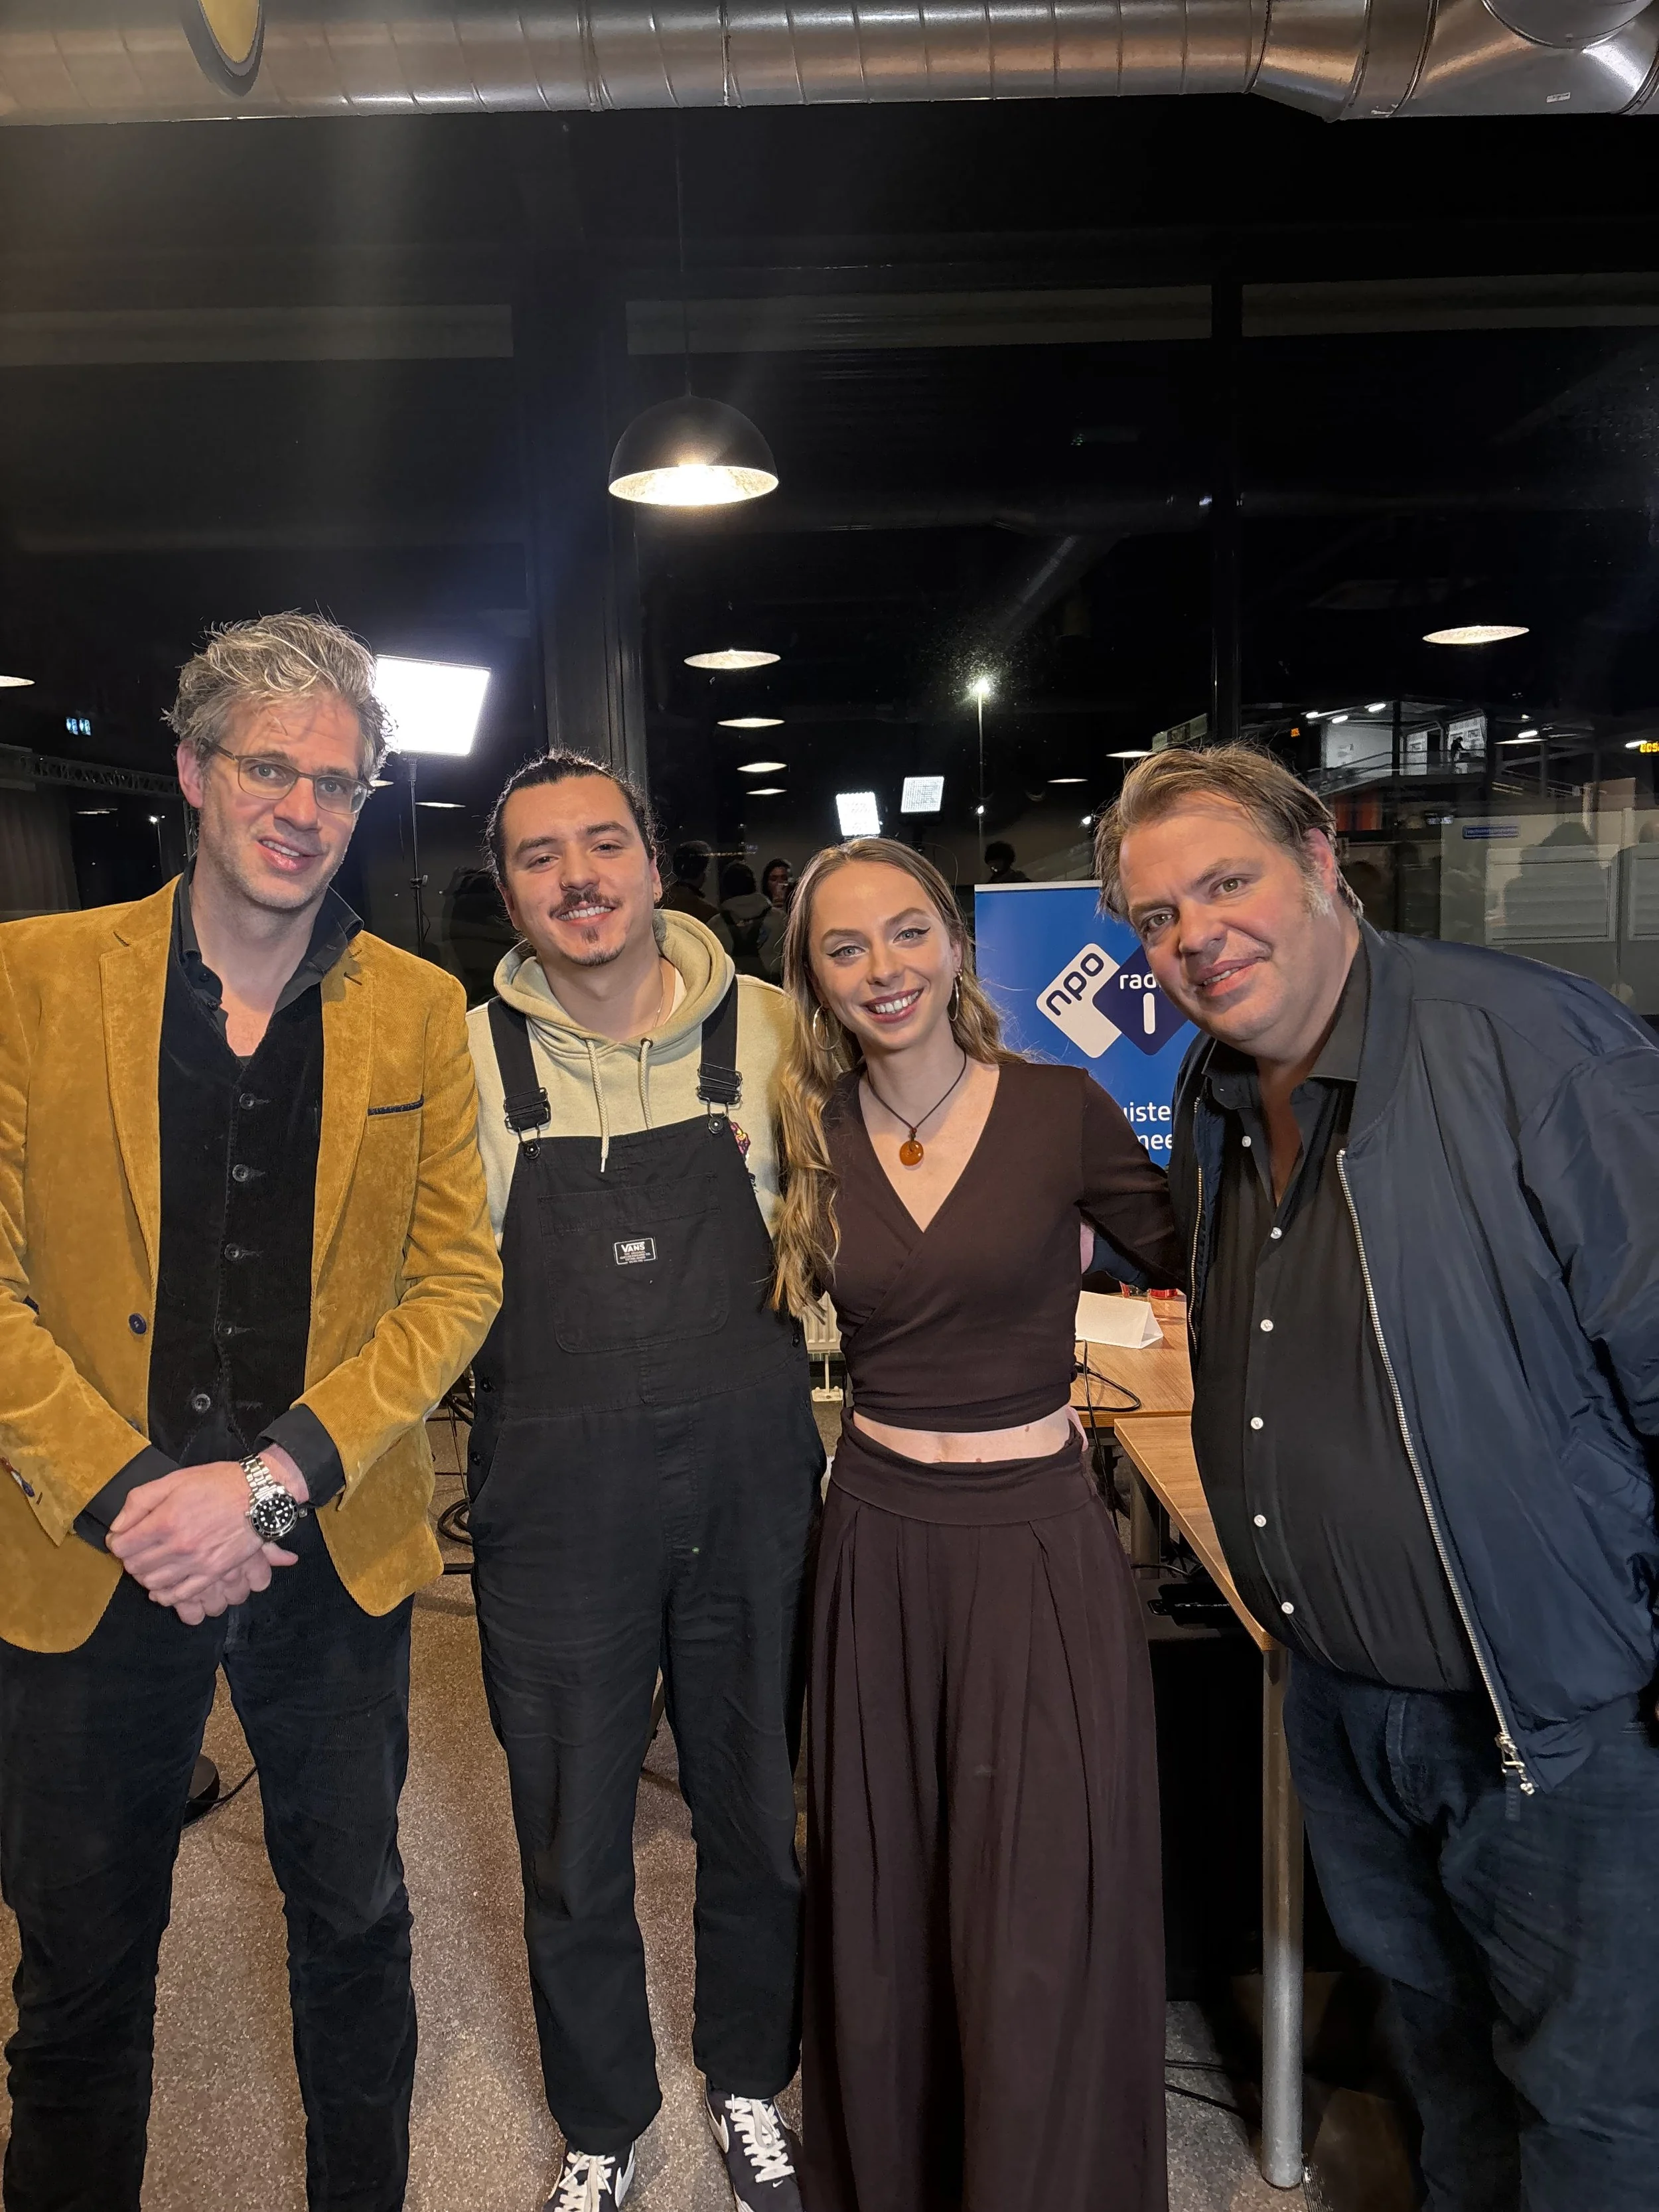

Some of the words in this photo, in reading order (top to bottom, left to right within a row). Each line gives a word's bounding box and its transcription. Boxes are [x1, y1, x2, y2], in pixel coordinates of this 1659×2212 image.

[1046, 952, 1104, 1016] npo
[1119, 973, 1161, 990] rad
[621, 1241, 646, 1253] VANS
